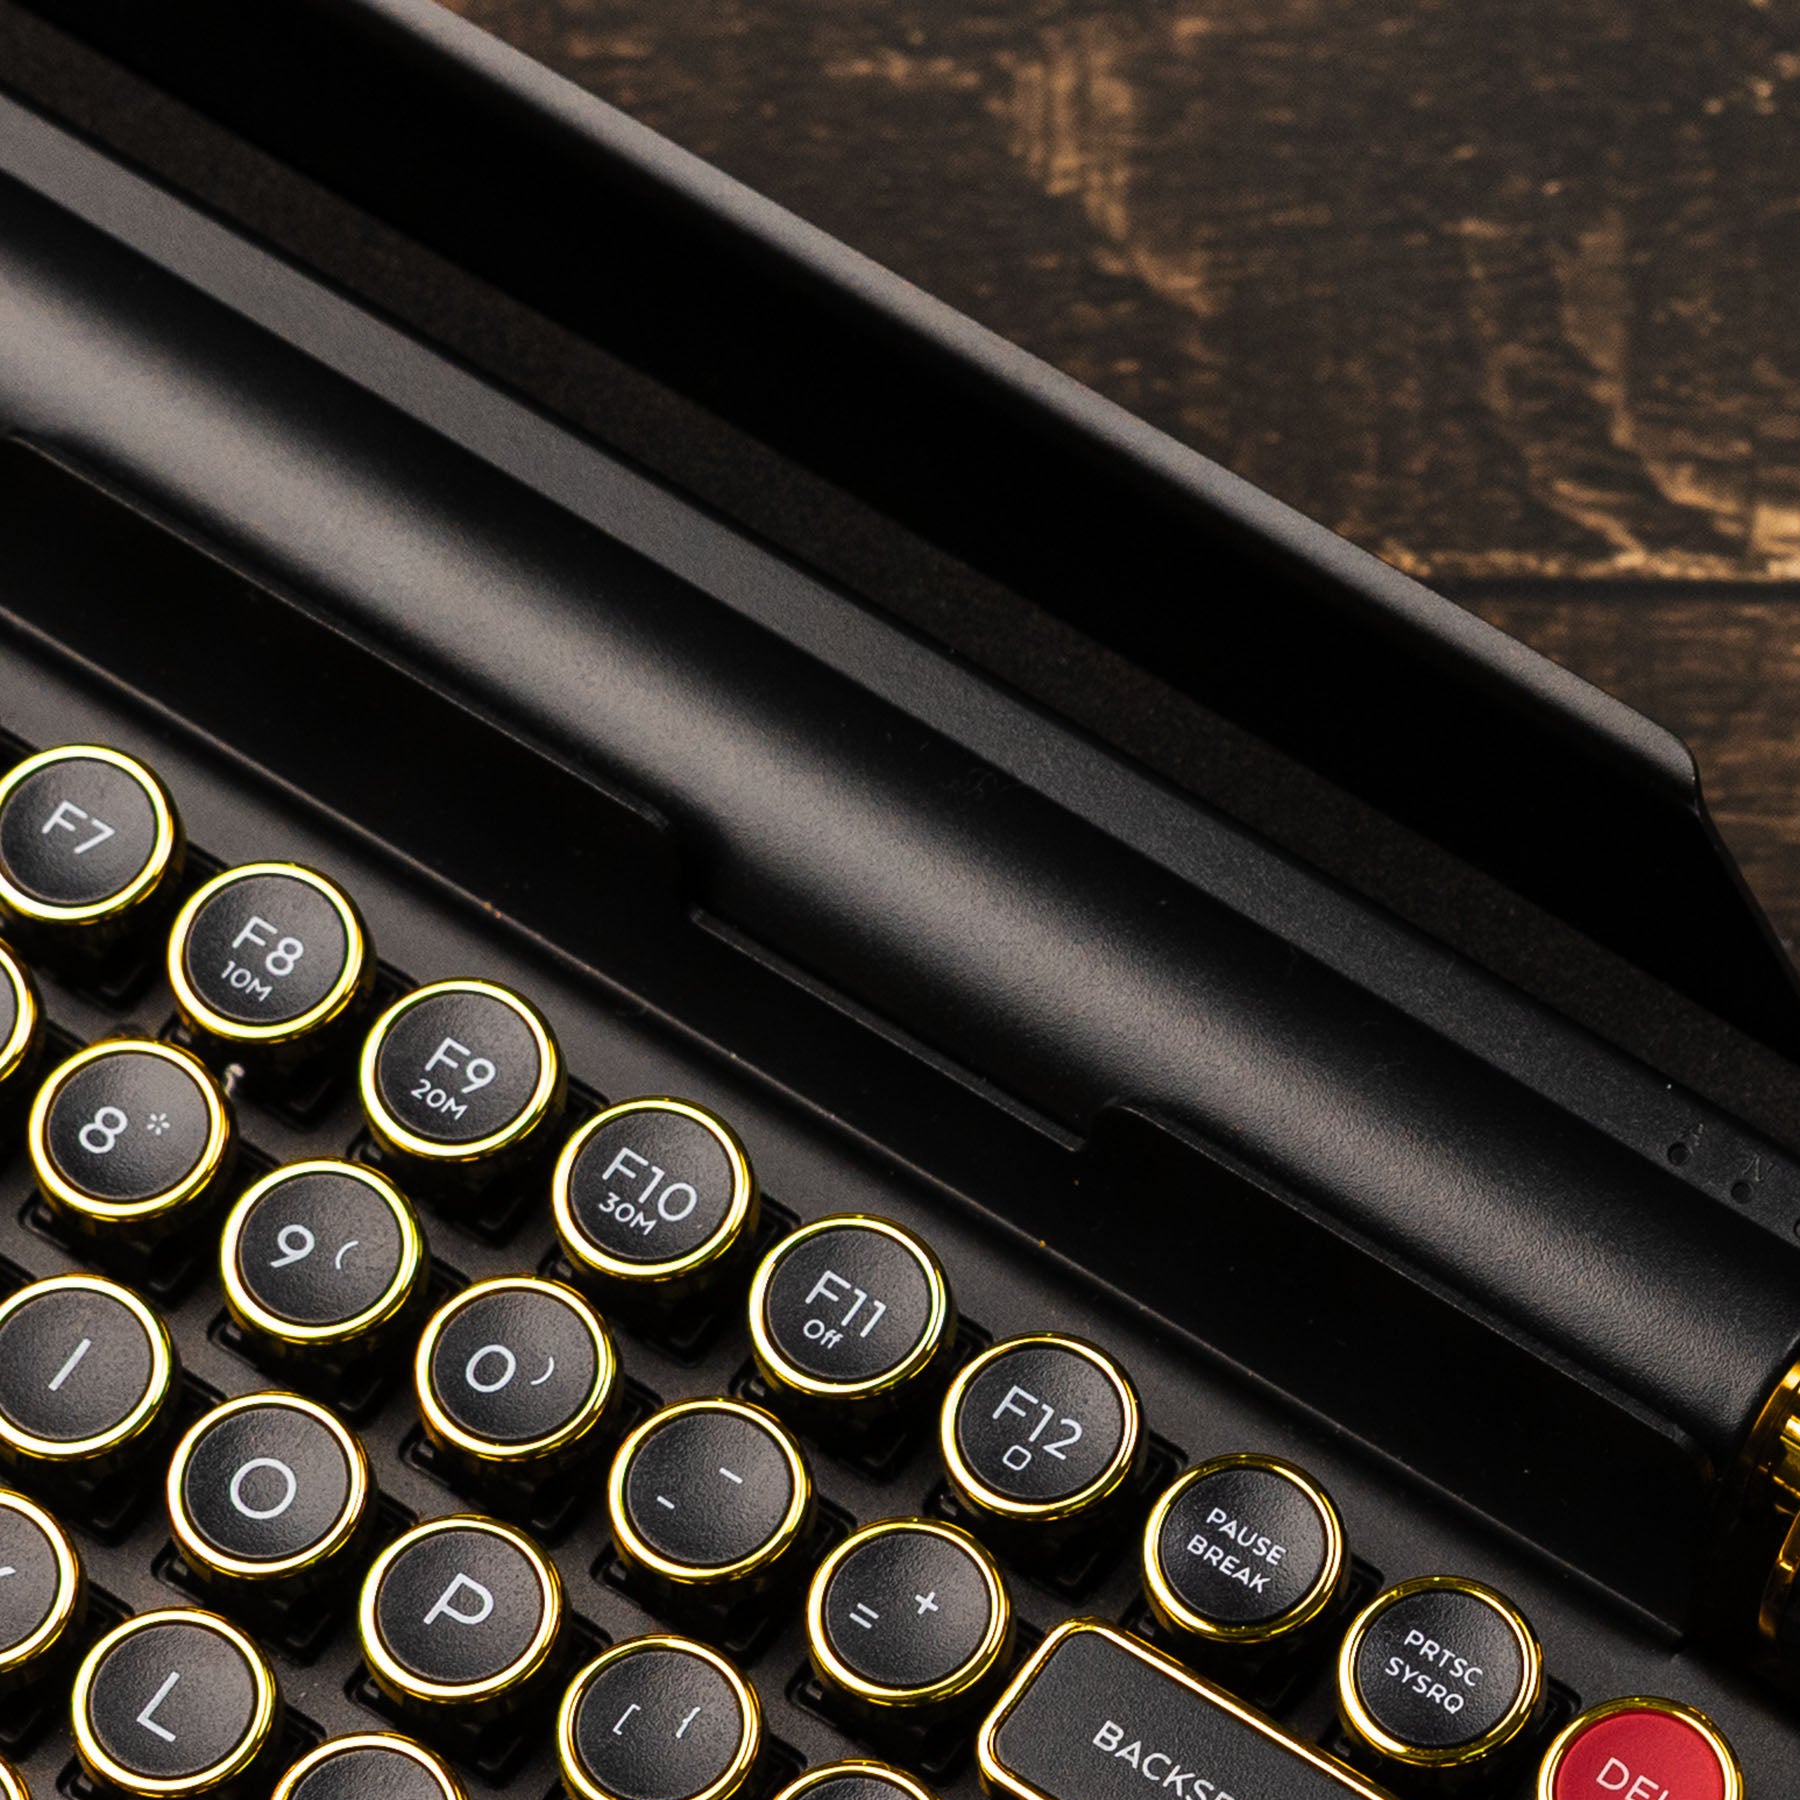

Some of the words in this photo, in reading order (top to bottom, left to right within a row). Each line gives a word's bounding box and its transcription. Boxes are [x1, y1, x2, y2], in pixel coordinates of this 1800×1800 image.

[42, 800, 115, 854] F7
[231, 915, 304, 976] F8
[220, 960, 272, 1002] 10M
[424, 1036, 497, 1094] F9
[410, 1078, 467, 1120] 20M
[79, 1106, 128, 1154] 8
[597, 1191, 658, 1236] 30M
[601, 1146, 698, 1223] F10
[270, 1224, 315, 1268] 9
[804, 1269, 888, 1340] F11
[802, 1318, 844, 1350] Off
[991, 1384, 1083, 1460] F12
[230, 1457, 297, 1520] O
[1186, 1533, 1271, 1595] BREAK
[1206, 1506, 1287, 1566] PAUSE
[423, 1572, 494, 1625] P
[849, 1602, 879, 1629] =
[915, 1591, 939, 1615] +
[1384, 1656, 1466, 1715] SYSRQ
[1402, 1628, 1484, 1688] PRTSC
[136, 1671, 180, 1742] L
